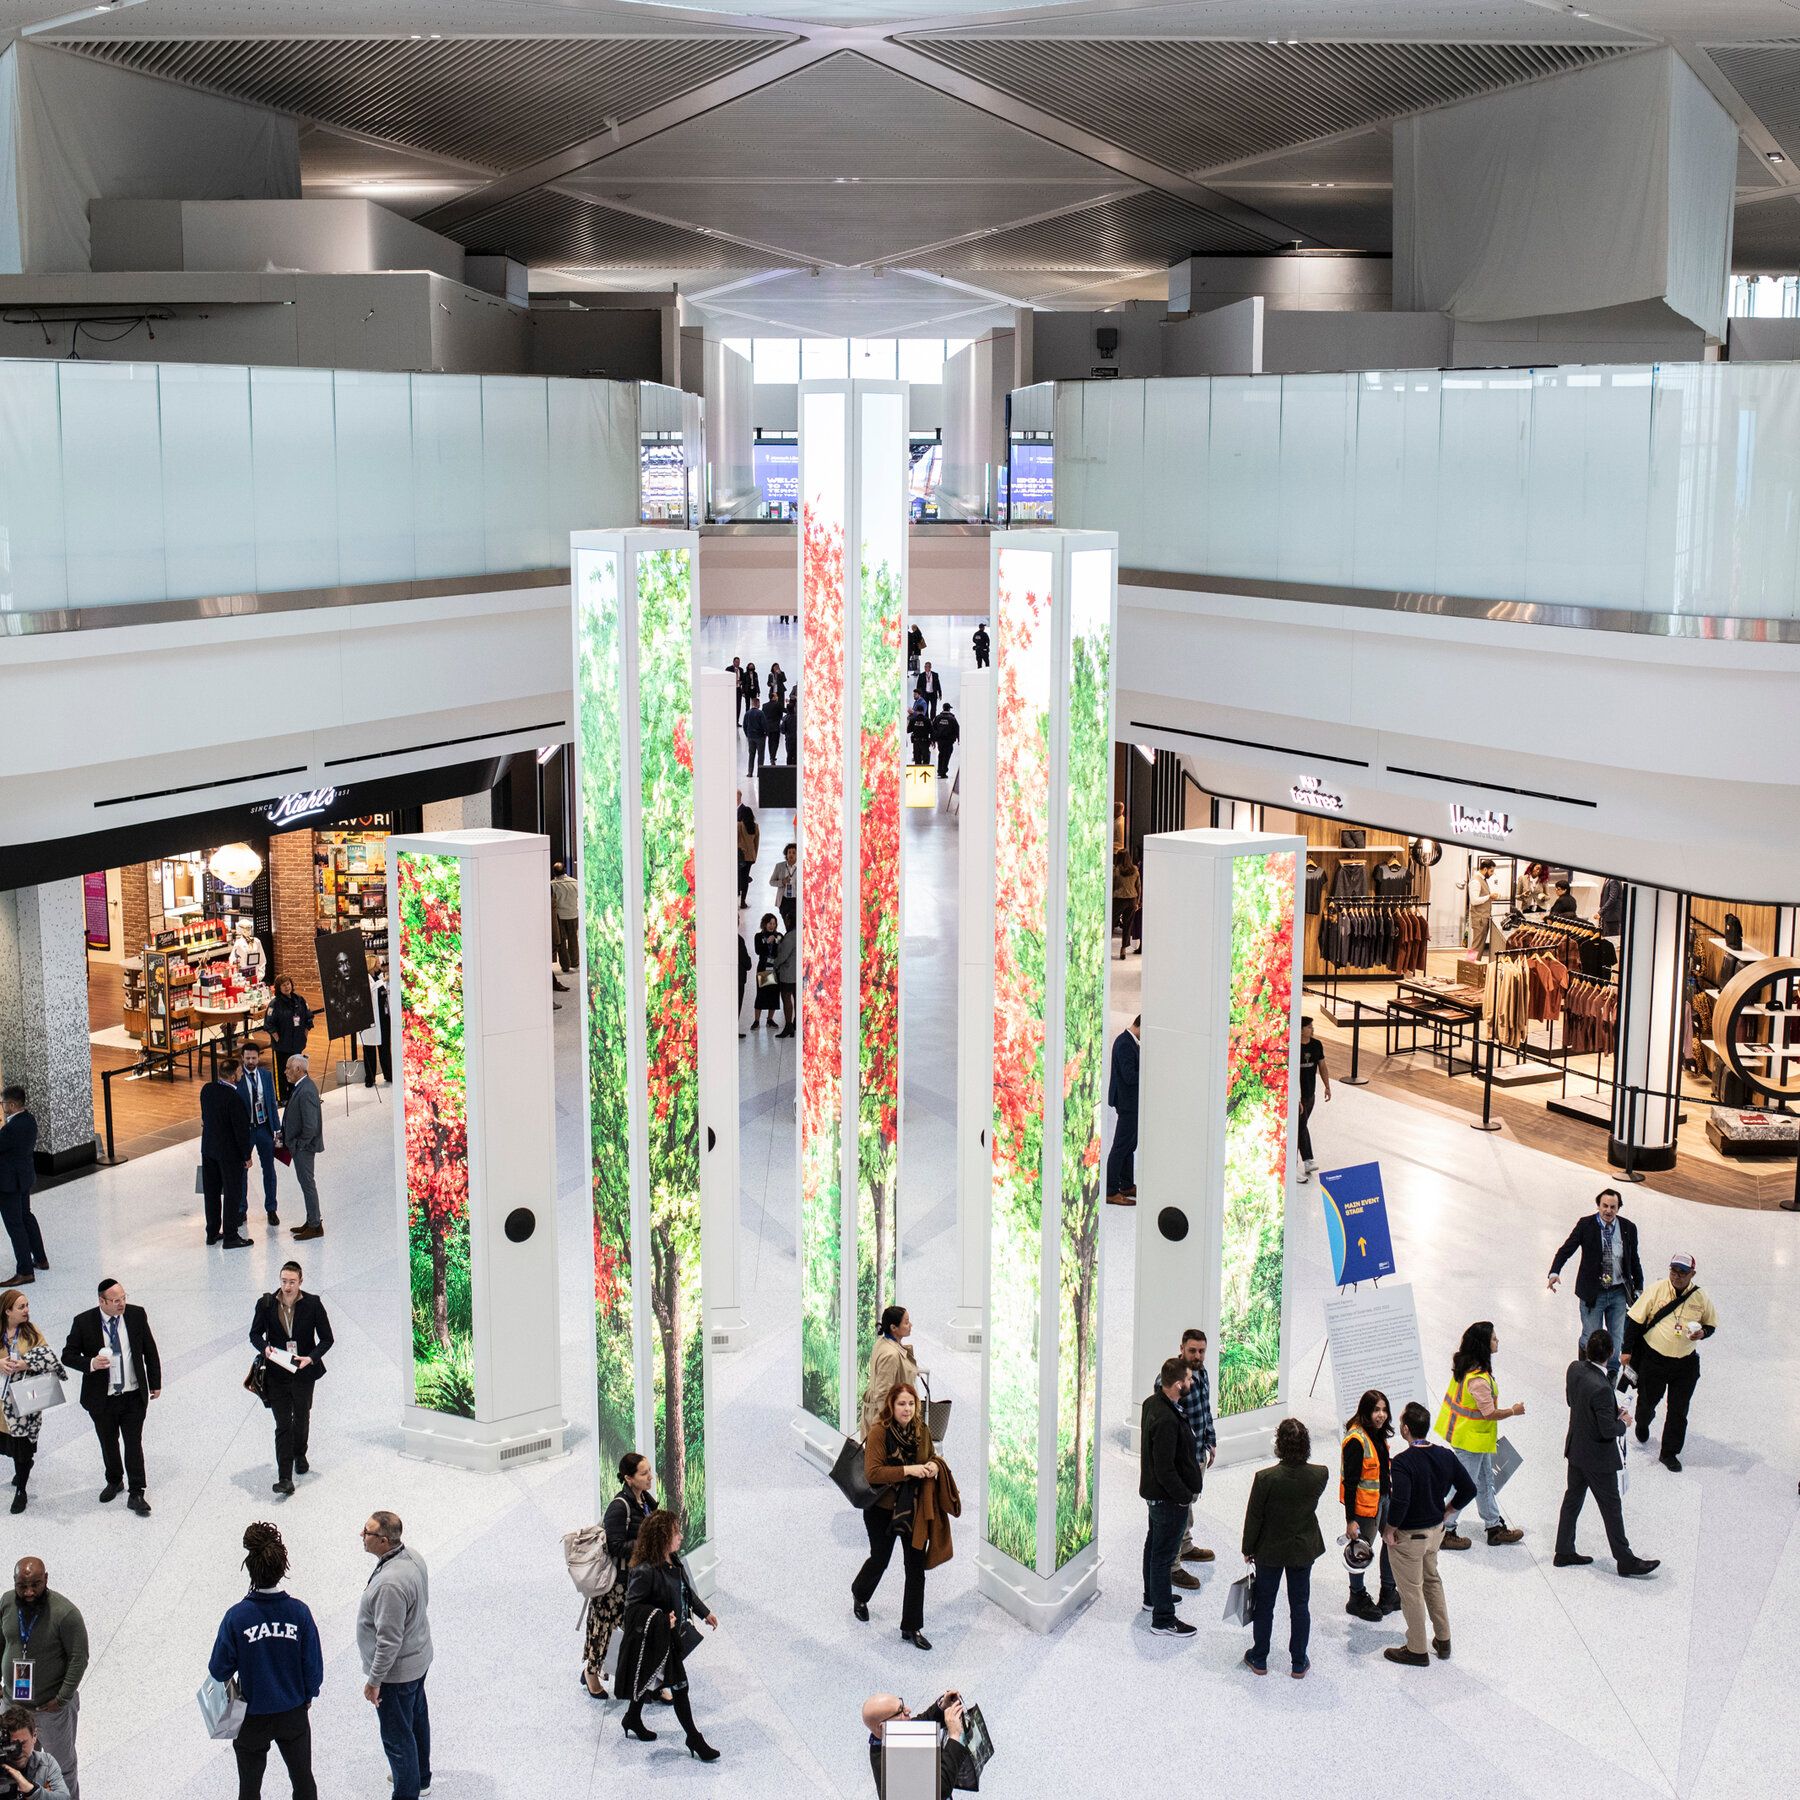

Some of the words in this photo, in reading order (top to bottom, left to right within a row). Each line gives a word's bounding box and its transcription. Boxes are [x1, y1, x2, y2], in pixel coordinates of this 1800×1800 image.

[250, 803, 273, 814] SINCE
[267, 786, 336, 821] Kiehl's
[1450, 803, 1509, 837] Herschel
[1344, 1200, 1361, 1210] MAIN
[1360, 1196, 1380, 1206] EVENT
[1345, 1206, 1364, 1216] STAGE
[243, 1622, 298, 1643] YALE
